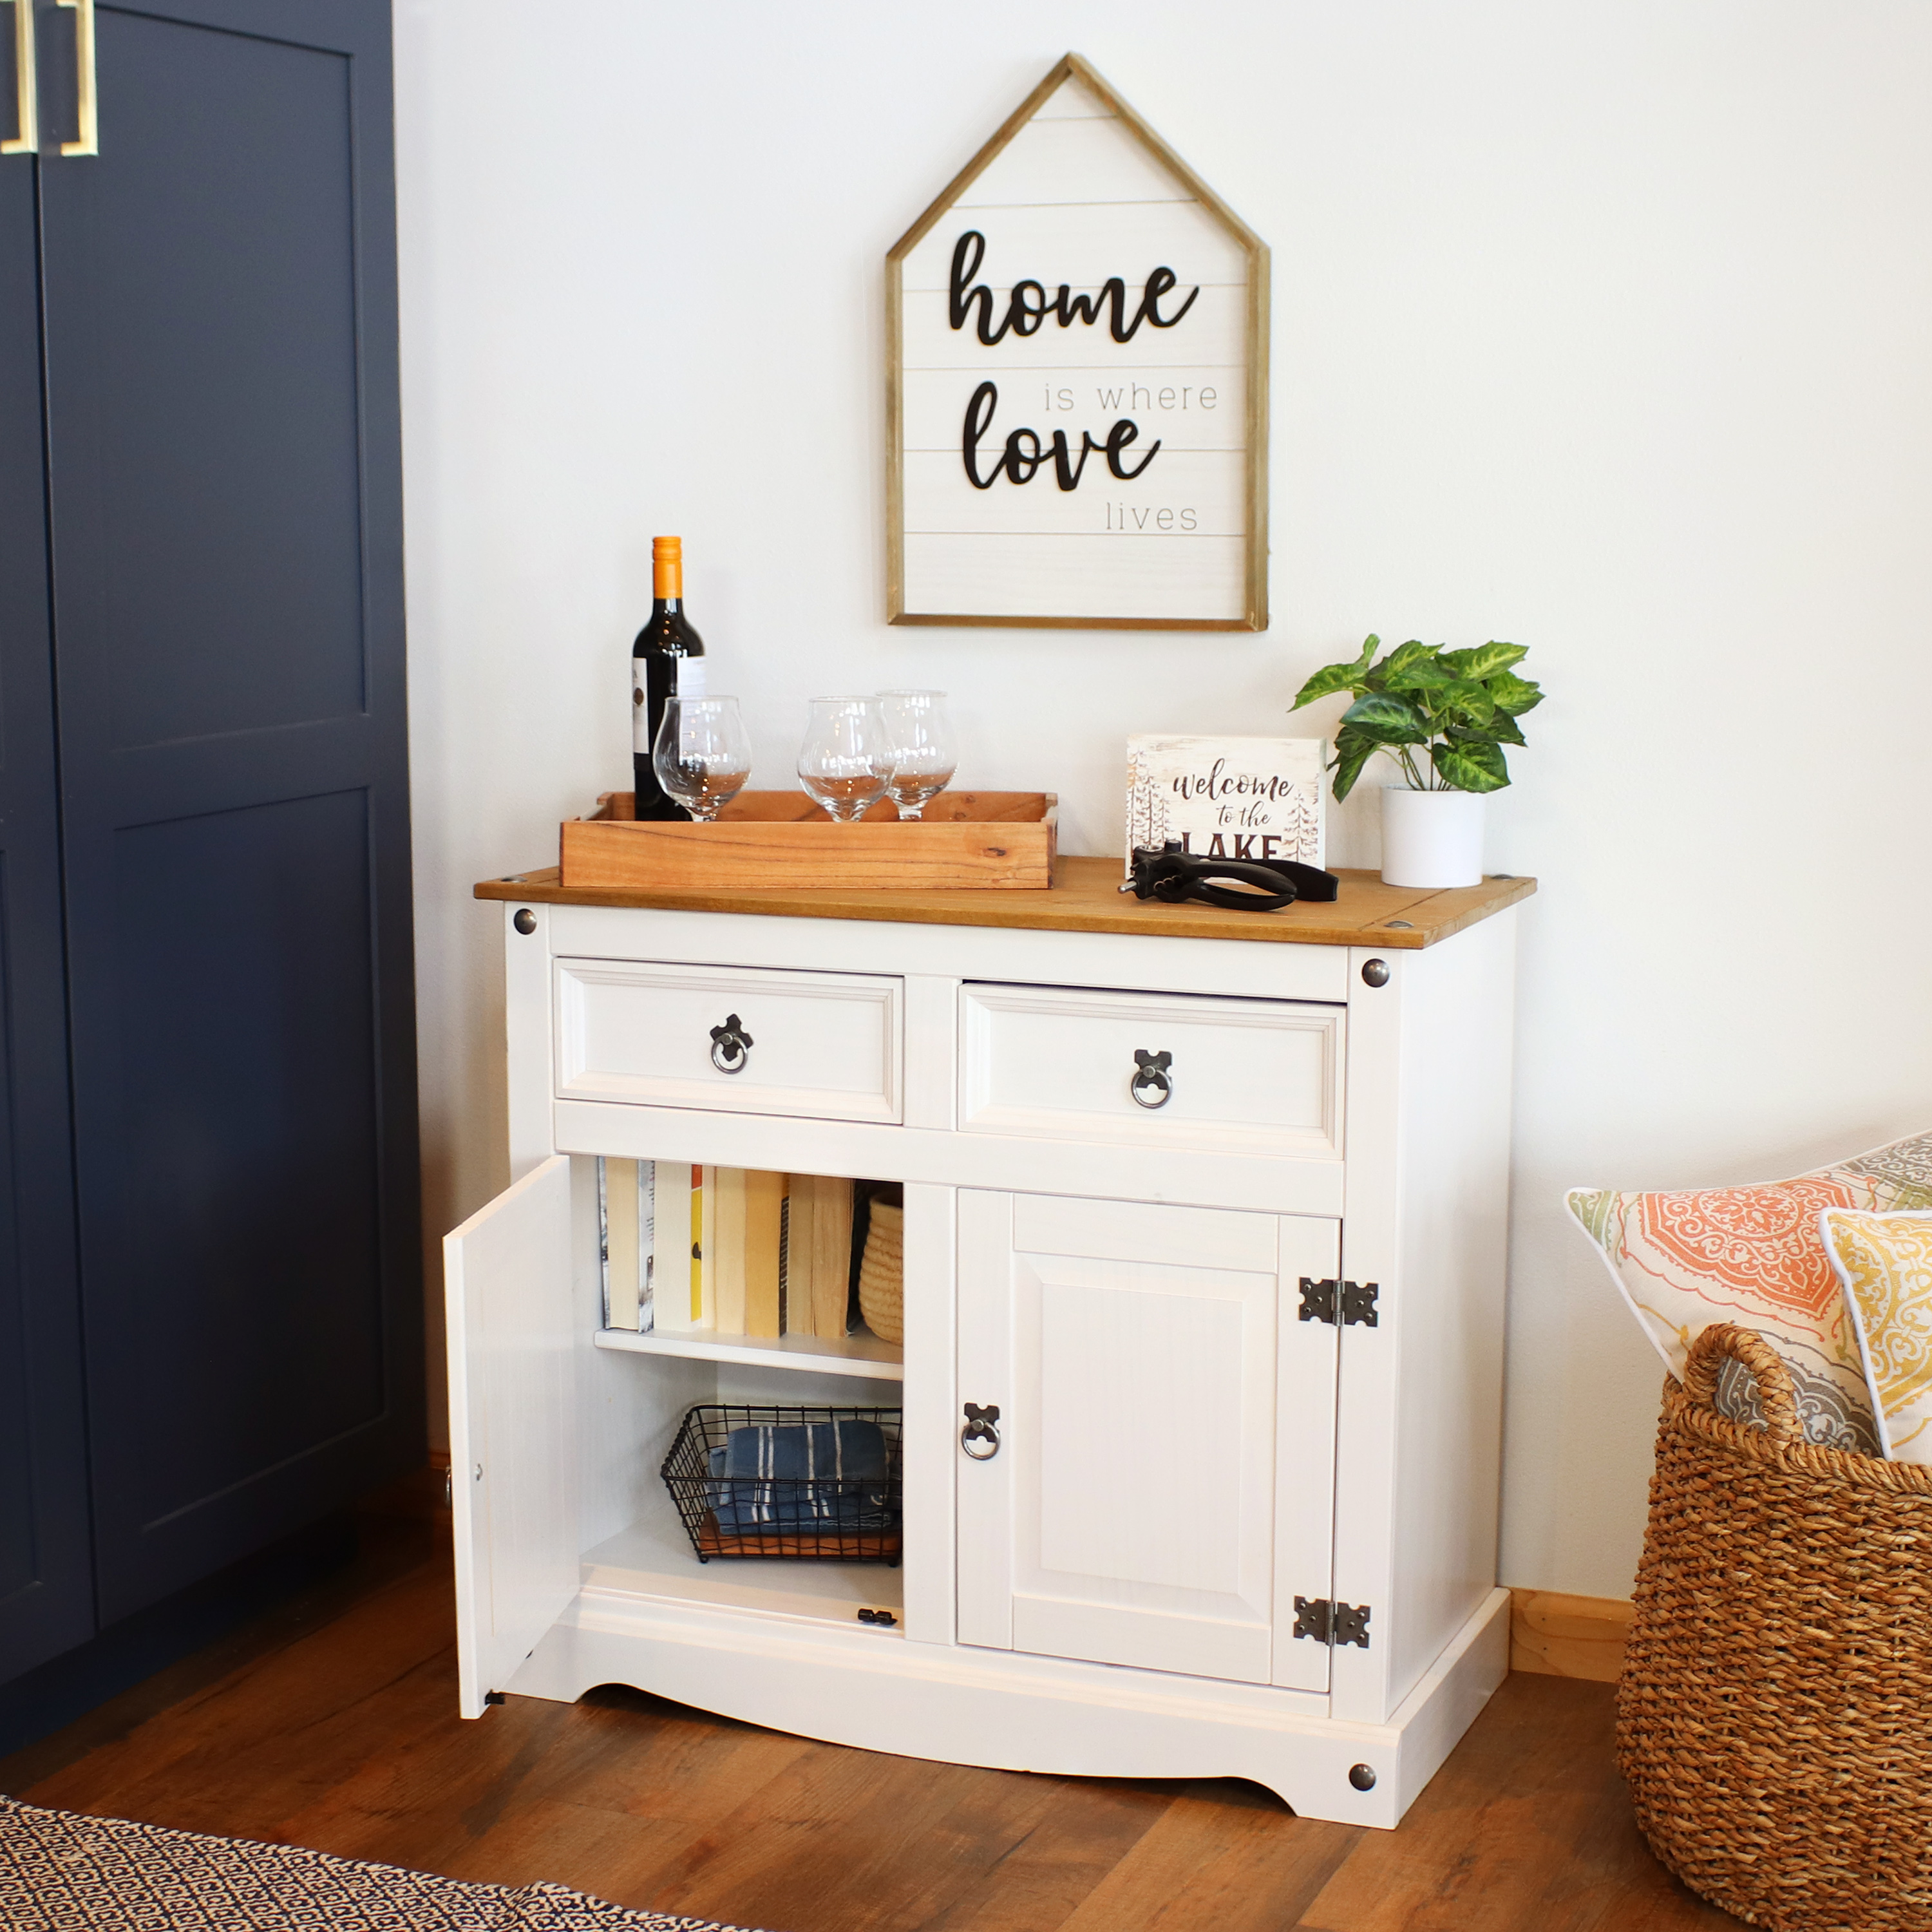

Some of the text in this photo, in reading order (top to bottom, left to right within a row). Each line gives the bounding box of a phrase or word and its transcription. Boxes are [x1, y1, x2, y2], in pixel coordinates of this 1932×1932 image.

[950, 230, 1200, 345] home
[1045, 382, 1218, 411] is where
[963, 381, 1161, 491] love
[1106, 502, 1198, 530] lives
[1173, 758, 1294, 800] welcome
[1216, 800, 1271, 827] to the
